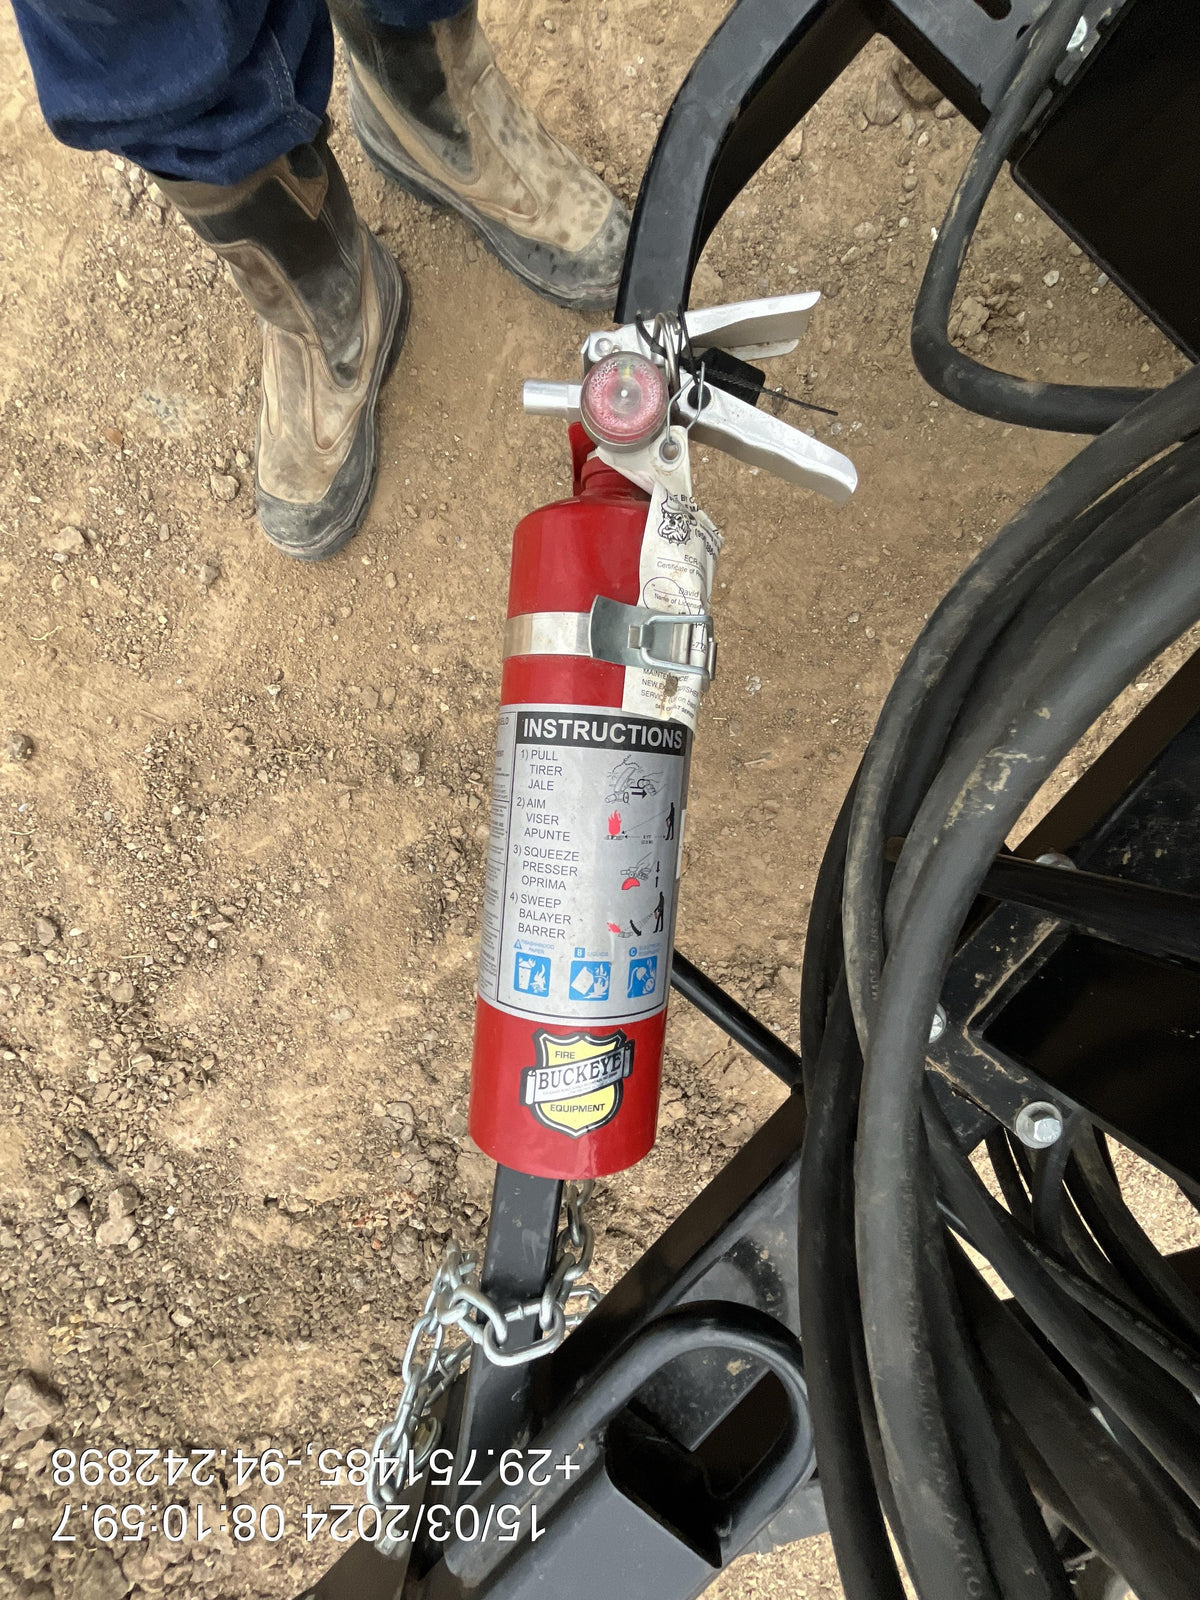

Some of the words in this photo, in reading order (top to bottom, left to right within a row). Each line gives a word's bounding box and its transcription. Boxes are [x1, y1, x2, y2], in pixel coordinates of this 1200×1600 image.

[656, 560, 688, 573] Certificate
[654, 593, 670, 602] Name
[678, 587, 700, 598] David
[641, 678, 658, 688] NEW
[522, 717, 683, 749] INSTRUCTIONS
[520, 749, 529, 761] 1)
[530, 749, 558, 762] PULL
[529, 764, 563, 777] TIRER
[527, 779, 554, 791] JALE
[516, 797, 525, 810] 2)
[526, 798, 546, 810] AIM
[526, 813, 560, 826] VISER
[523, 829, 571, 842] APUNTE
[512, 844, 522, 857] 3)
[524, 845, 580, 862] SQUEEZE
[522, 860, 578, 877] PRESSER
[521, 874, 567, 891] OPRIMA
[509, 893, 519, 905] 4)
[520, 893, 562, 909] SWEEP
[518, 908, 572, 925] BALAYER
[517, 922, 566, 940] BARRER
[554, 1050, 576, 1060] FIRE
[537, 1052, 623, 1091] BUCKEYE
[549, 1103, 606, 1113] EQUIPMENT
